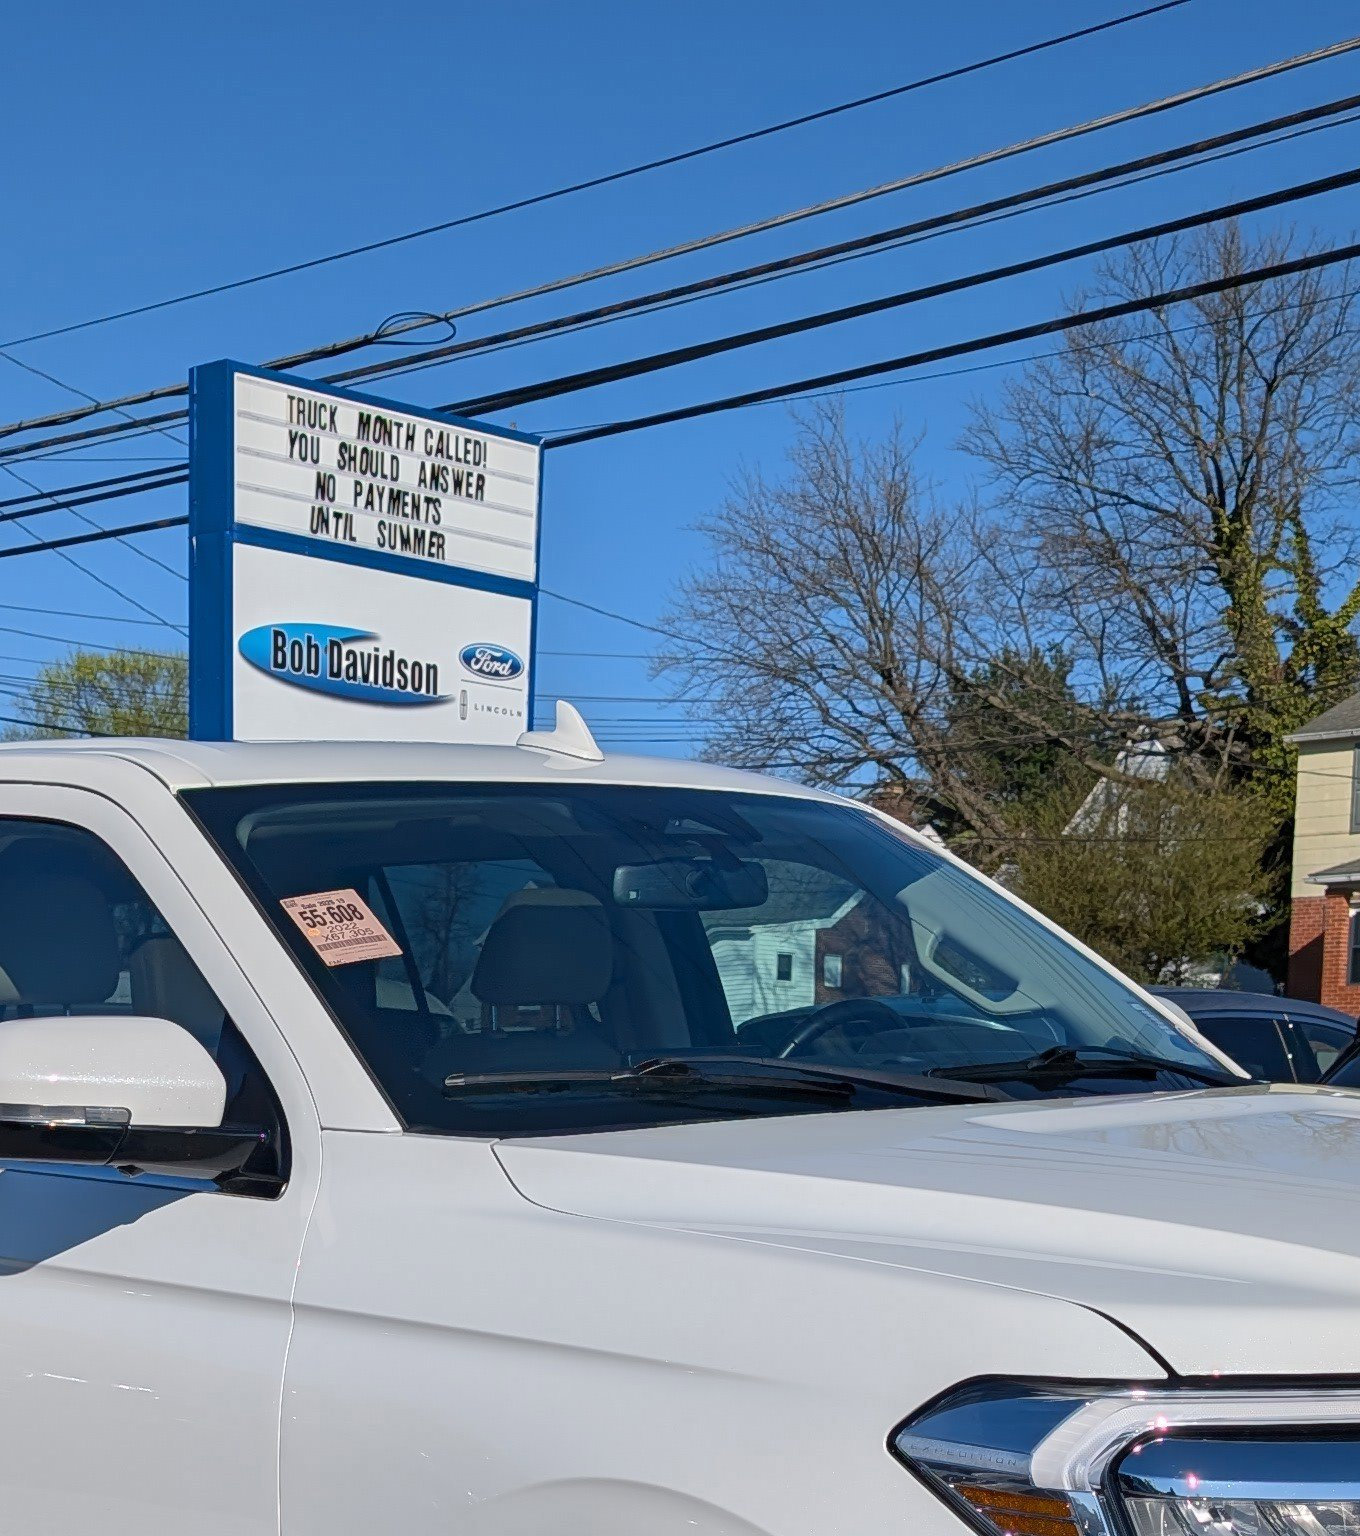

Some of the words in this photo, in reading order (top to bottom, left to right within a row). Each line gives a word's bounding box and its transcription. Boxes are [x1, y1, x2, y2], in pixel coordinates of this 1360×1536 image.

[287, 394, 338, 434] TRUCK
[356, 411, 416, 451] MONTH
[424, 428, 488, 468] CALLED!
[288, 429, 320, 464] YOU
[337, 441, 400, 482] SHOULD
[417, 461, 486, 501] ANSWER
[315, 471, 336, 503] NO
[353, 480, 442, 525] PAYMENTS
[310, 505, 357, 543] UNTIL
[377, 519, 446, 560] SUMMER
[272, 629, 319, 676] Bob
[328, 638, 439, 695] Davidson
[470, 647, 513, 677] Ford
[474, 703, 523, 718] LINCOLN
[298, 903, 365, 928] 55:608
[327, 922, 360, 933] 2022
